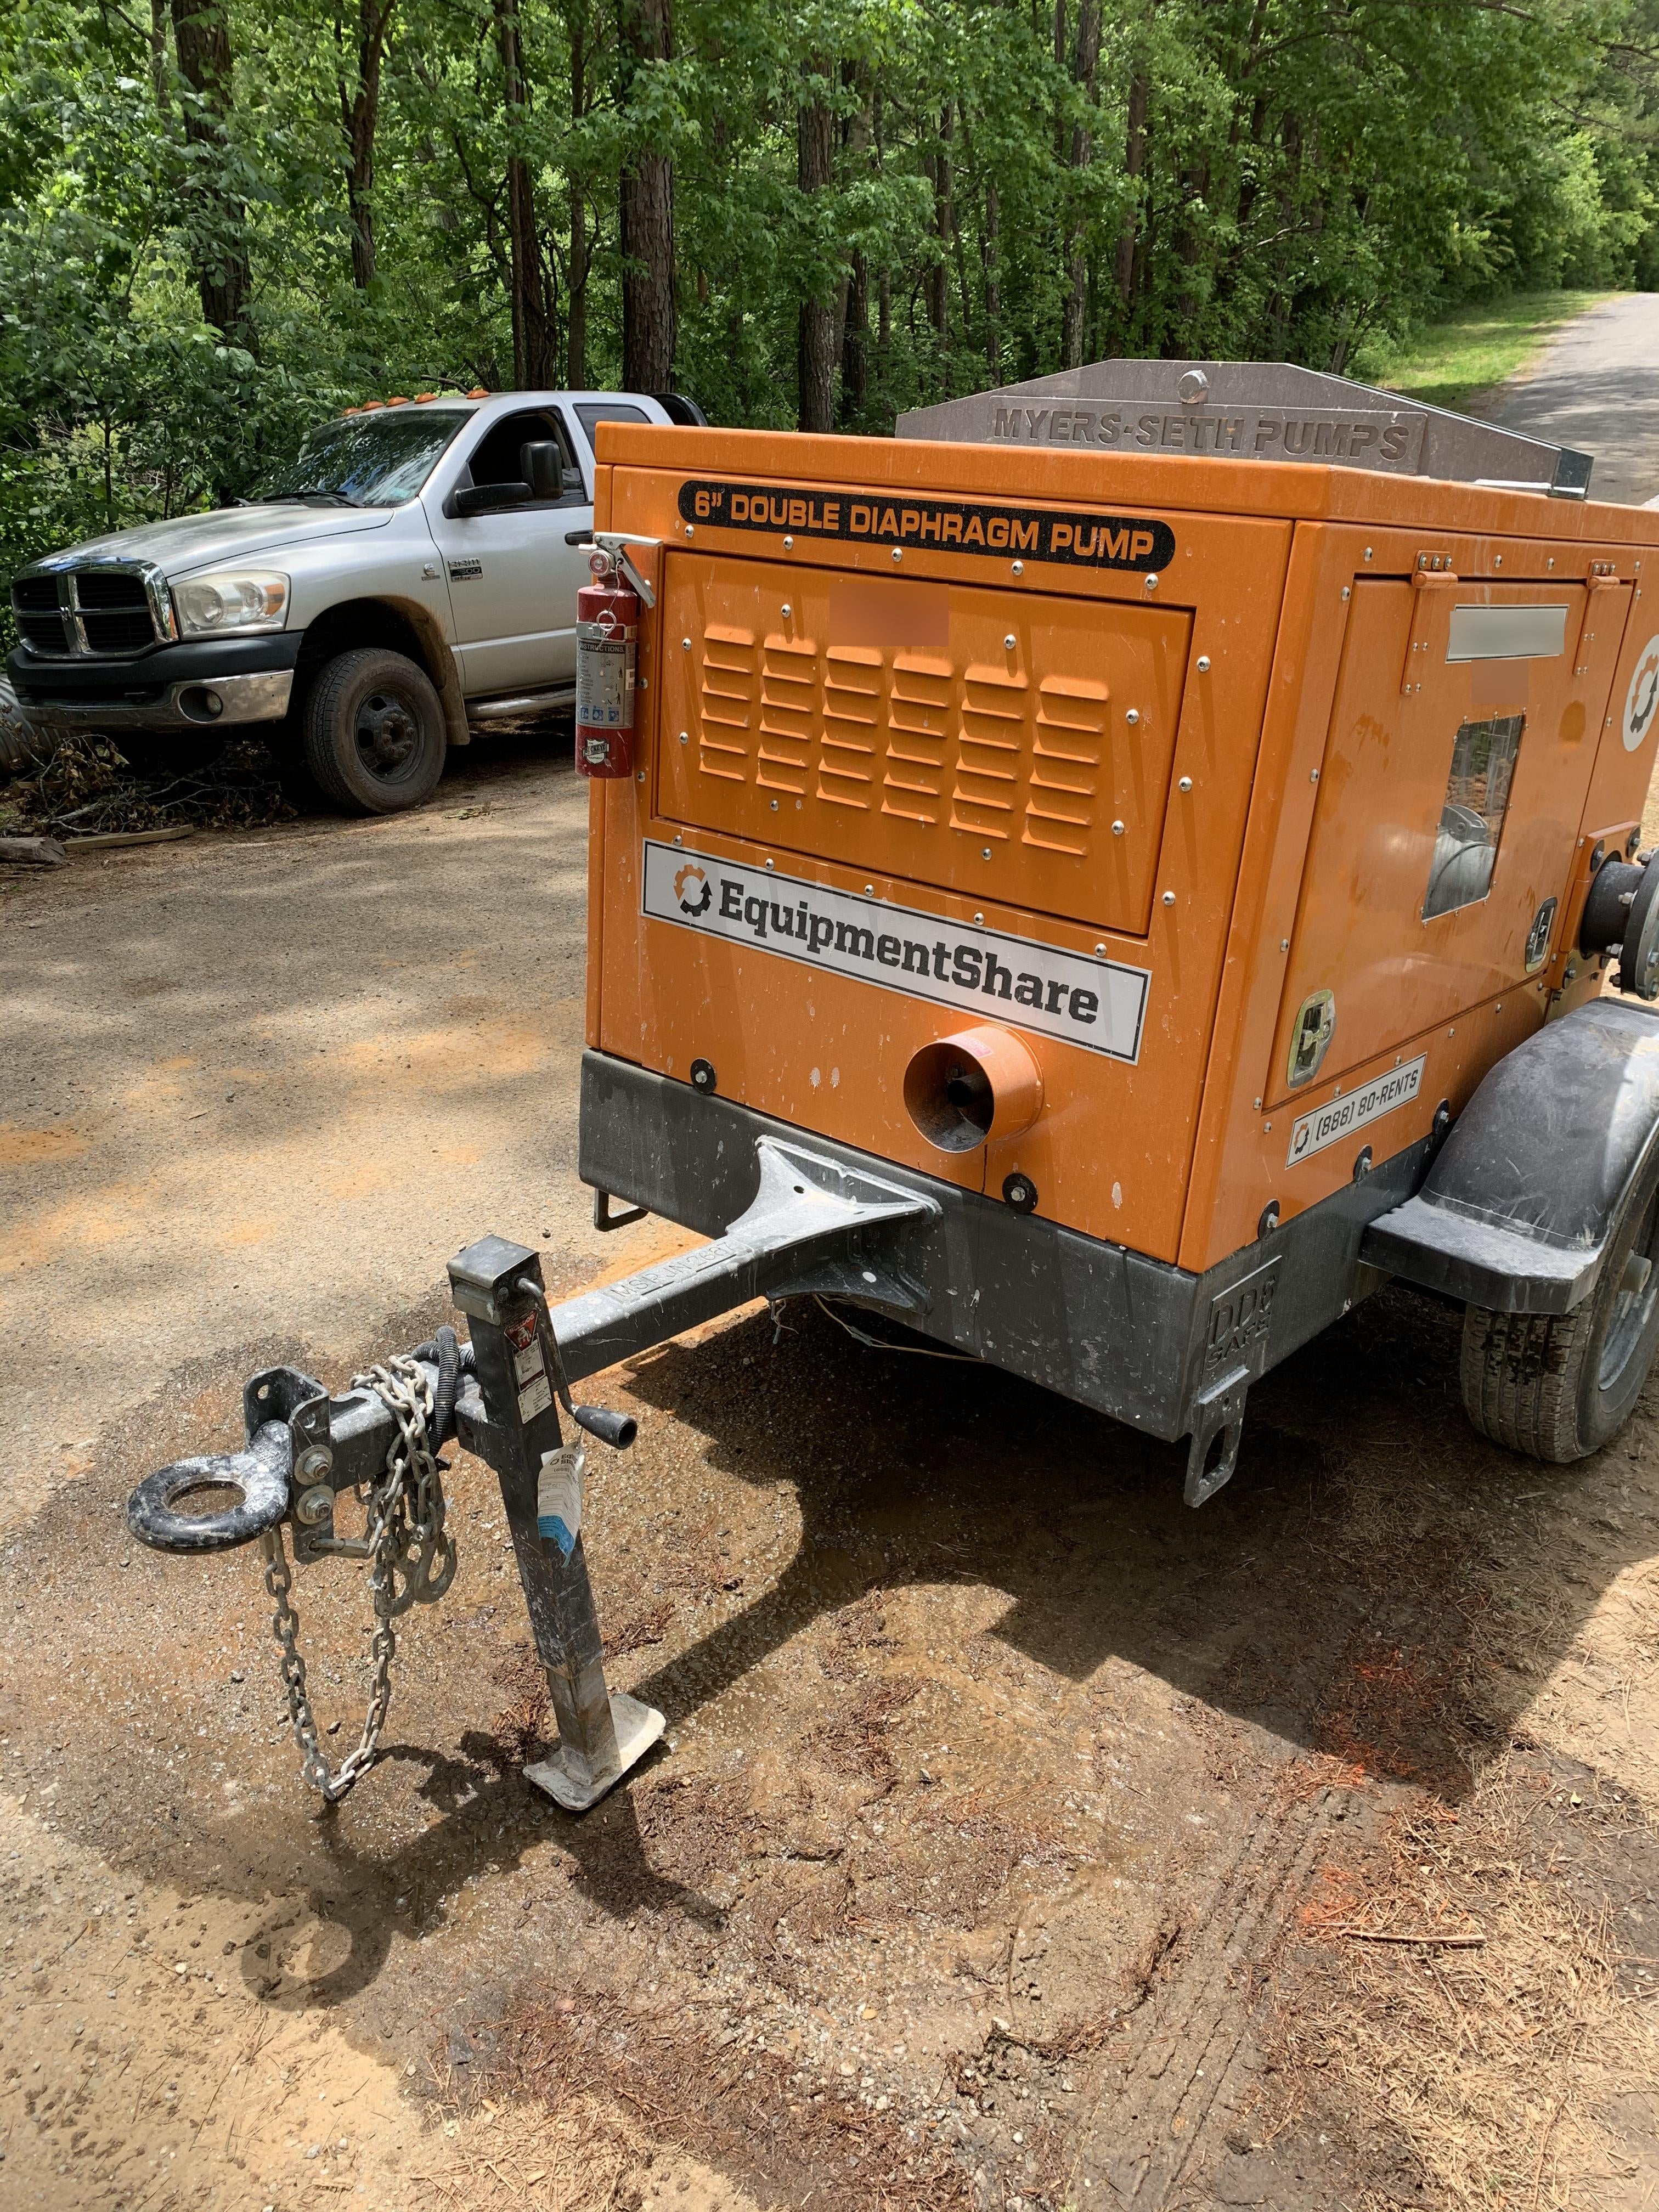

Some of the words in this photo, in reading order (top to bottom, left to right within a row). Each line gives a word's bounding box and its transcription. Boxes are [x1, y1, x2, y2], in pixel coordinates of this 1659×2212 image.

[993, 408, 1245, 452] MYERS-SETH
[1255, 420, 1410, 461] PUMPS
[731, 493, 840, 530] DOUBLE
[850, 504, 1040, 551] DIAPHRAGM
[1049, 523, 1154, 561] PUMP
[719, 878, 1099, 1025] EquipmentShare
[1316, 1101, 1355, 1141] (888)
[1357, 1069, 1419, 1118] 80-RENTS
[1206, 1311, 1272, 1372] SAFE
